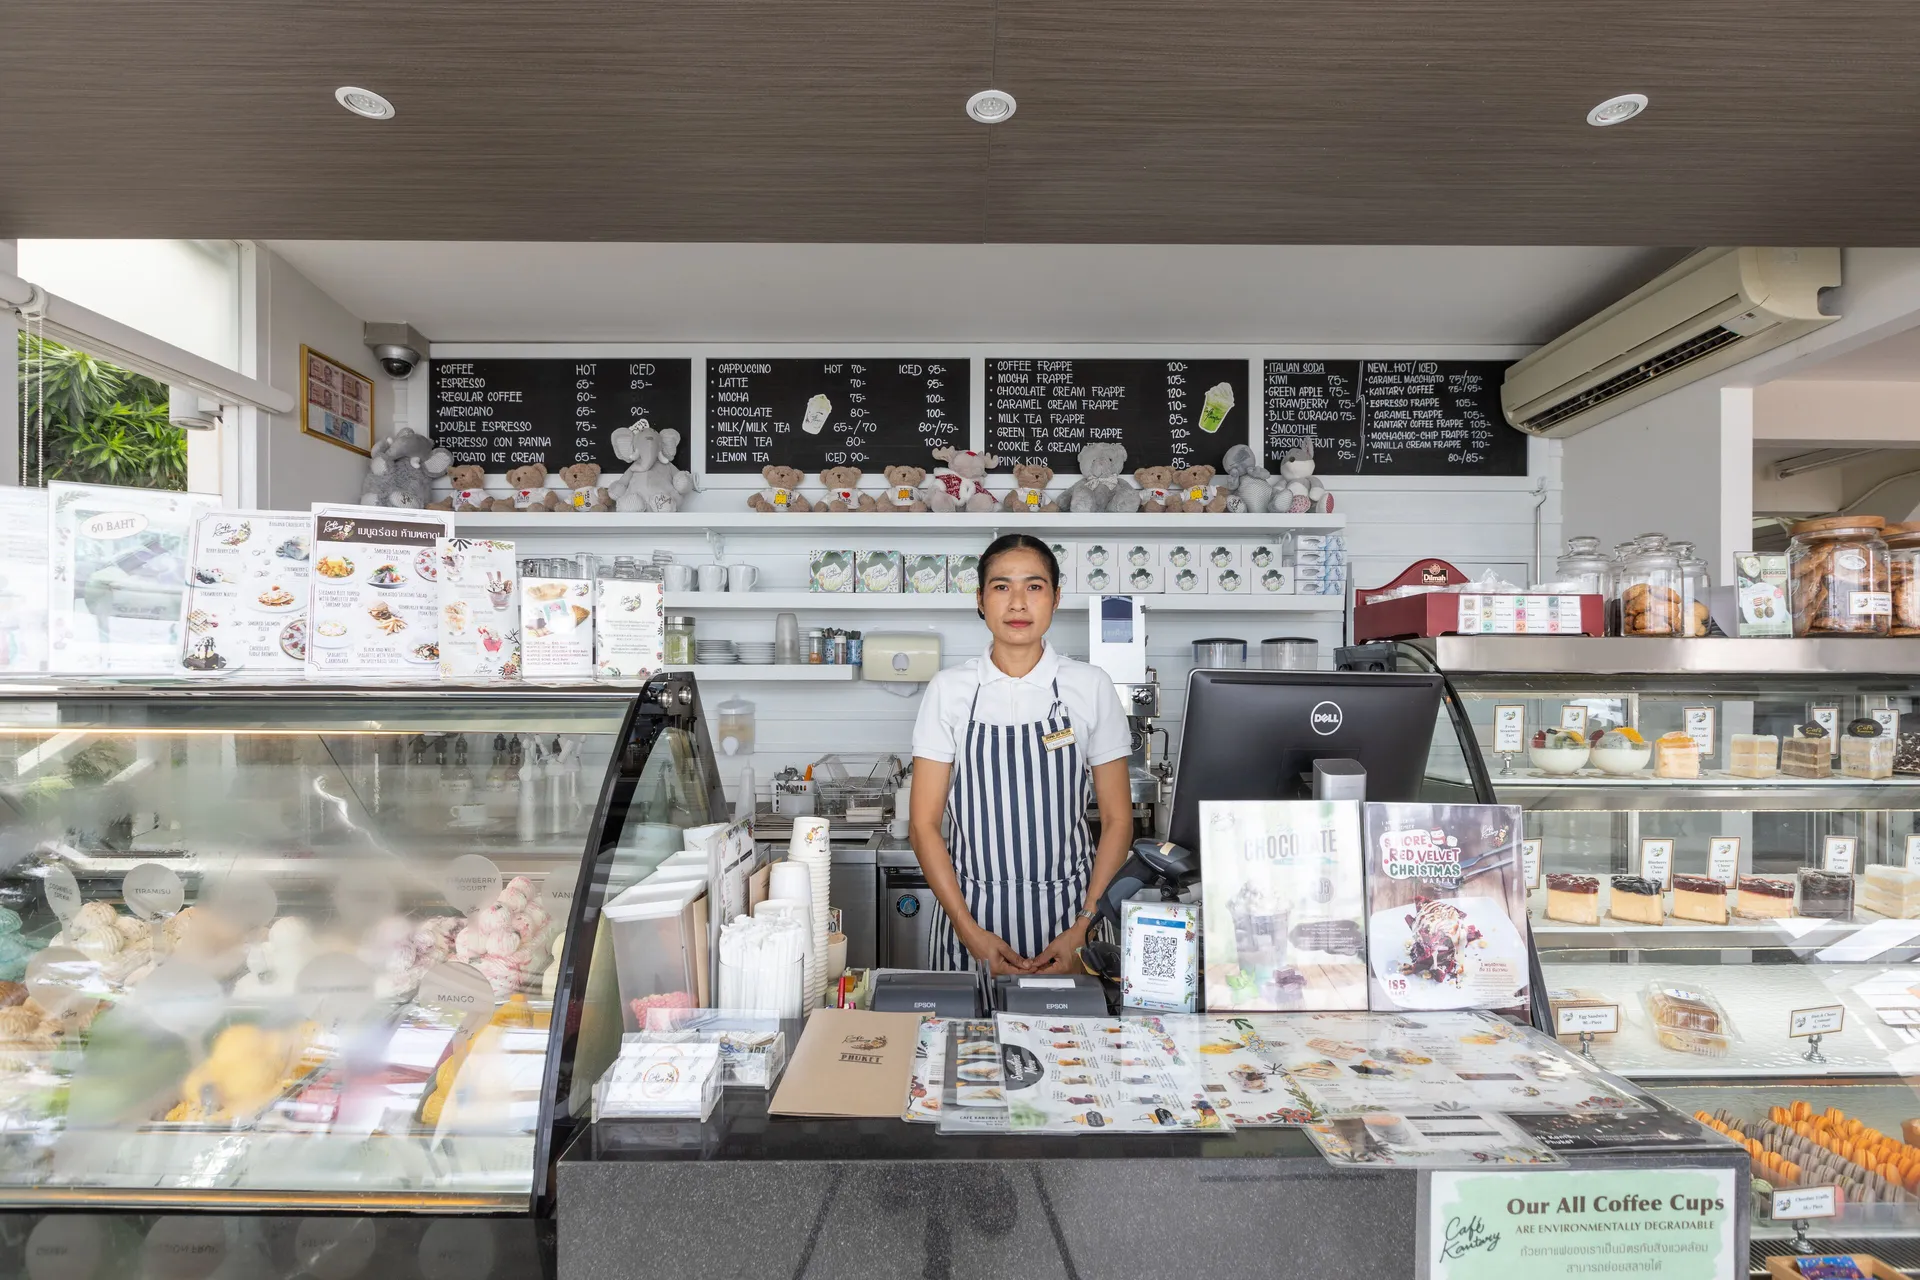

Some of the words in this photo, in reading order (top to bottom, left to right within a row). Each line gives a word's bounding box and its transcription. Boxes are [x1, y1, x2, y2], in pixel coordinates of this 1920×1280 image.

[441, 364, 473, 374] COFFEE
[576, 364, 596, 375] HOT
[630, 364, 655, 375] ICED
[719, 364, 771, 373] CAPPUCCINO
[825, 364, 843, 373] HOT
[899, 365, 922, 376] ICED
[998, 361, 1031, 371] COFFEE
[1038, 361, 1072, 371] FRAPPE
[1269, 364, 1299, 373] ITALIAN
[1303, 364, 1324, 372] SODA
[1419, 363, 1437, 374] ICED
[442, 378, 485, 388] ESPRESSO
[719, 377, 748, 387] LATTE
[998, 374, 1028, 383] MOCHA
[1037, 374, 1073, 384] FRAPPE
[1270, 375, 1287, 384] KIWI
[1369, 375, 1402, 384] CARAMEL
[1404, 375, 1444, 383] MACCHIATO
[997, 386, 1045, 396] CHOCOLATE
[1053, 386, 1085, 396] CREAM
[1092, 386, 1125, 397] FRAPPE
[1269, 386, 1295, 396] GREEN
[1299, 387, 1322, 397] APPLE
[1370, 386, 1404, 396] KANTARY
[1407, 385, 1434, 394] COFFEE
[441, 392, 483, 402] REGULAR
[488, 392, 522, 402] COFFEE
[719, 392, 749, 402] MOCHA
[1370, 399, 1408, 407] ESPRESSO
[1411, 398, 1439, 406] FRAPPE
[997, 399, 1041, 409] CARAMEL
[1048, 400, 1077, 410] CREAM
[1082, 400, 1118, 410] FRAPPE
[1269, 398, 1328, 410] STRAWBERRY
[439, 406, 493, 417] AMERICANO
[717, 407, 772, 417] CHOCOLATE
[1269, 410, 1294, 421] BLUE
[1298, 410, 1338, 421] CURACAO
[1374, 410, 1411, 419] CARAMEL
[1413, 410, 1442, 419] FRAPPE
[999, 413, 1019, 423] MILK
[1024, 414, 1042, 424] TEA
[1050, 414, 1085, 424] FRAPPE
[1374, 420, 1407, 428] KANTARY
[1410, 420, 1433, 428] COFFEE
[1437, 419, 1463, 427] FRAPPE
[439, 421, 476, 432] DOUBLE
[482, 421, 531, 432] ESPRESSO
[718, 420, 767, 435] MILK/MILK
[774, 422, 790, 433] TEA
[1271, 423, 1317, 434] SMOOTHIE
[997, 427, 1025, 439] GREEN
[1031, 427, 1048, 437] TEA
[1053, 427, 1084, 438] CREAM
[1090, 428, 1122, 439] FRAPPE
[1441, 430, 1468, 439] FRAPPE
[440, 437, 487, 447] ESPRESSO
[494, 437, 512, 447] CON
[519, 437, 551, 446] PANNA
[717, 436, 747, 447] GREEN
[754, 437, 772, 447] TEA
[998, 439, 1029, 451] COOKIE
[1034, 440, 1043, 451] &
[1048, 442, 1080, 452] CREAM
[1371, 441, 1403, 449] VANILLA
[1433, 440, 1461, 448] FRAPPE
[452, 452, 486, 462] FOGATO
[492, 452, 506, 462] ICE
[511, 452, 544, 463] CREAM
[716, 452, 746, 462] LEMON
[752, 452, 769, 462] TEA
[826, 452, 846, 464] ICED
[999, 456, 1021, 467] PINK
[1026, 457, 1048, 467] KIDS
[1373, 453, 1392, 463] TEA
[91, 523, 103, 533] 60
[107, 518, 136, 530] BAHT
[1315, 713, 1338, 724] DELL
[1244, 829, 1337, 861] CHOCOATE
[1390, 848, 1414, 861] RED
[1418, 849, 1460, 862] VELVET
[1390, 863, 1460, 876] CHRISTMAS
[1389, 980, 1406, 989] 185
[438, 995, 474, 1003] MANGO
[841, 1054, 880, 1063] PHUKET
[1507, 1198, 1549, 1215] Our
[1556, 1196, 1585, 1214] All
[1594, 1195, 1662, 1213] Coffee
[1670, 1194, 1725, 1216] Cups
[1445, 1215, 1484, 1240] Café
[1515, 1224, 1535, 1234] ARE
[1539, 1221, 1640, 1233] ENVIRONMENTALLY
[1644, 1220, 1715, 1231] DEGRADABLE
